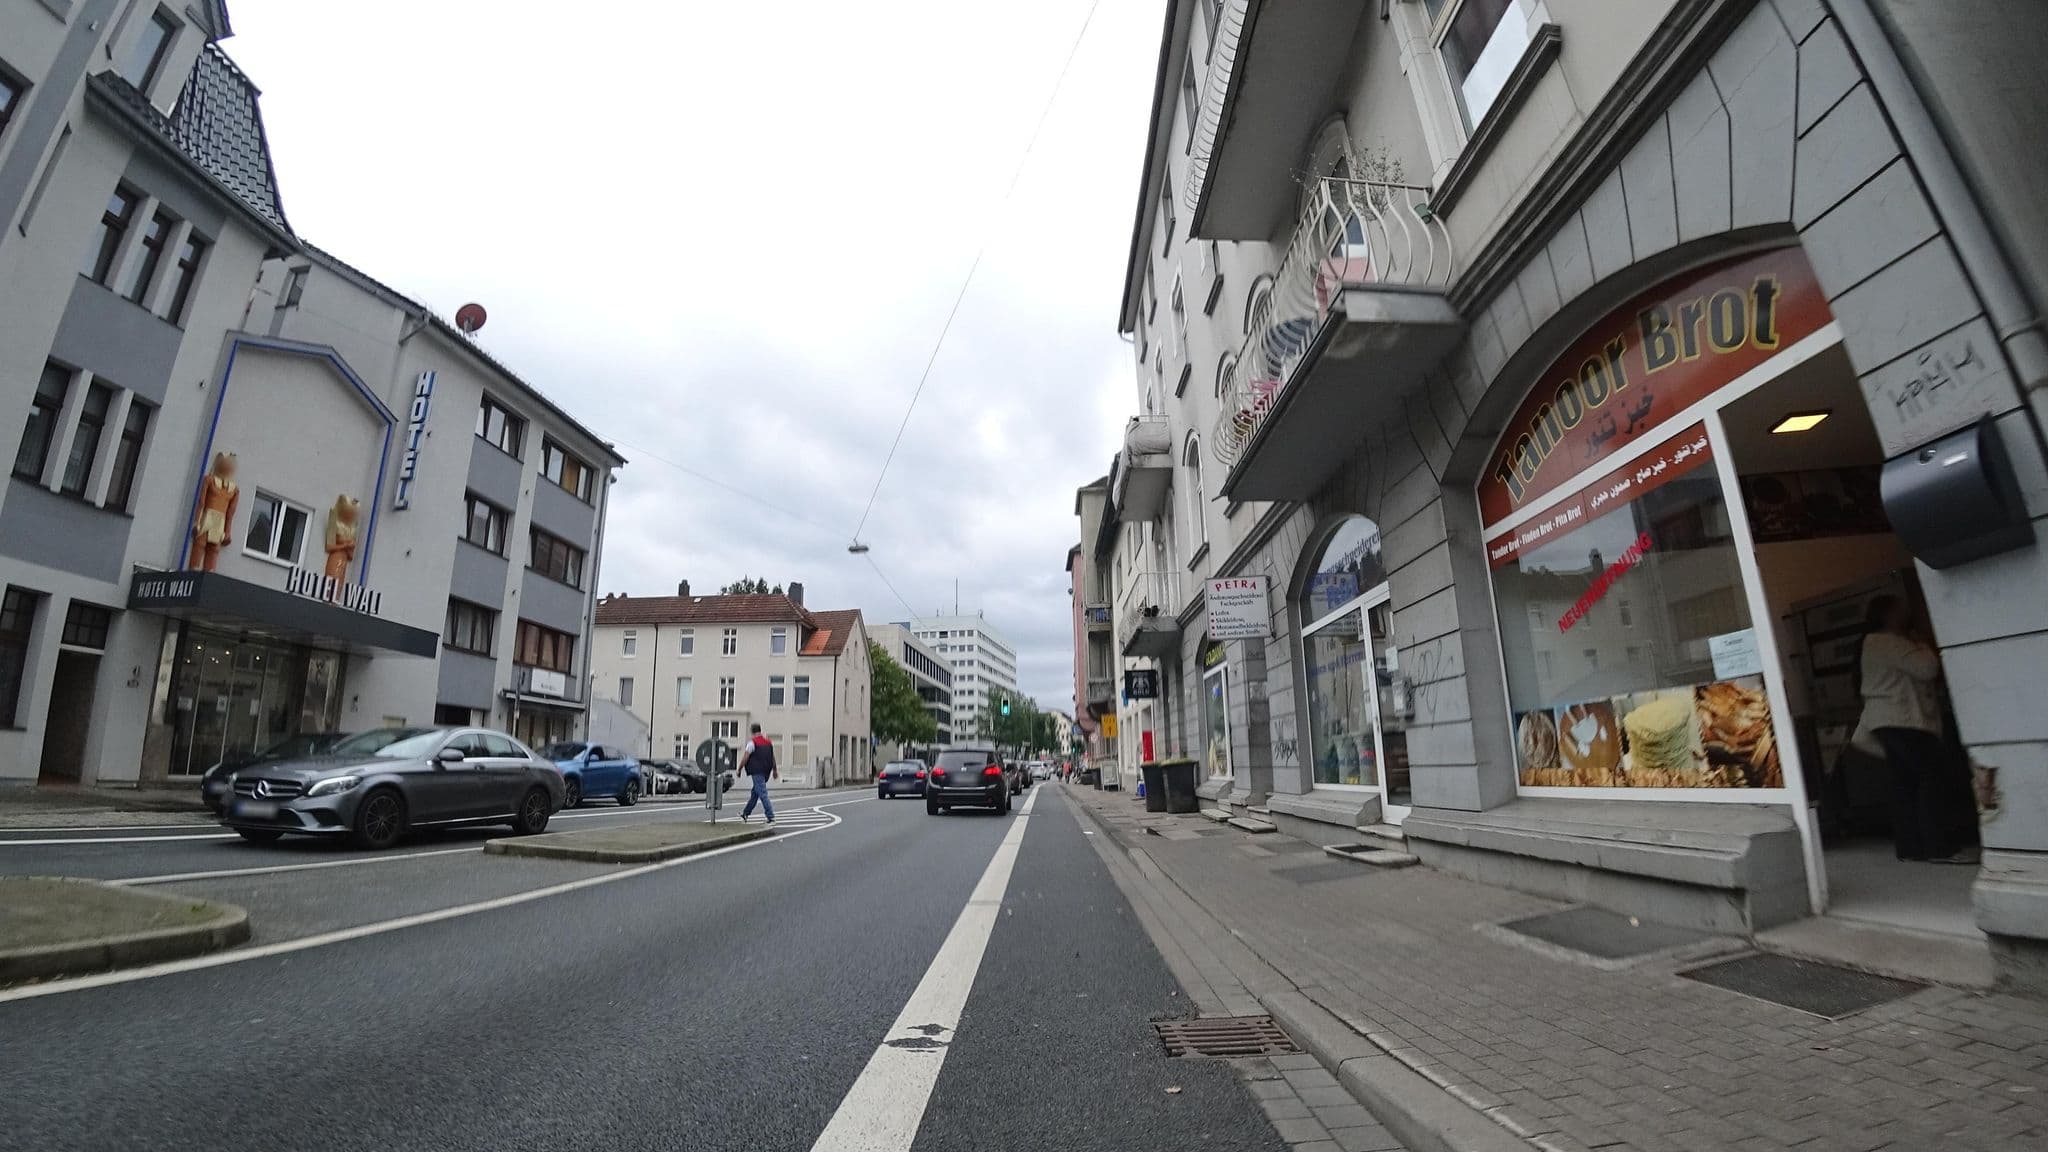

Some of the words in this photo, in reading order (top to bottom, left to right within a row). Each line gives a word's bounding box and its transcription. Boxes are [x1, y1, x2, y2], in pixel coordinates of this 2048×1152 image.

[1495, 333, 1628, 504] Tanoor
[1638, 274, 1781, 375] Brot
[393, 370, 437, 511] HOTEL
[137, 582, 166, 599] HOTEL
[168, 580, 194, 598] WALI
[287, 567, 341, 605] HOTEL
[344, 582, 384, 615] WALI
[1215, 580, 1256, 592] PETRA
